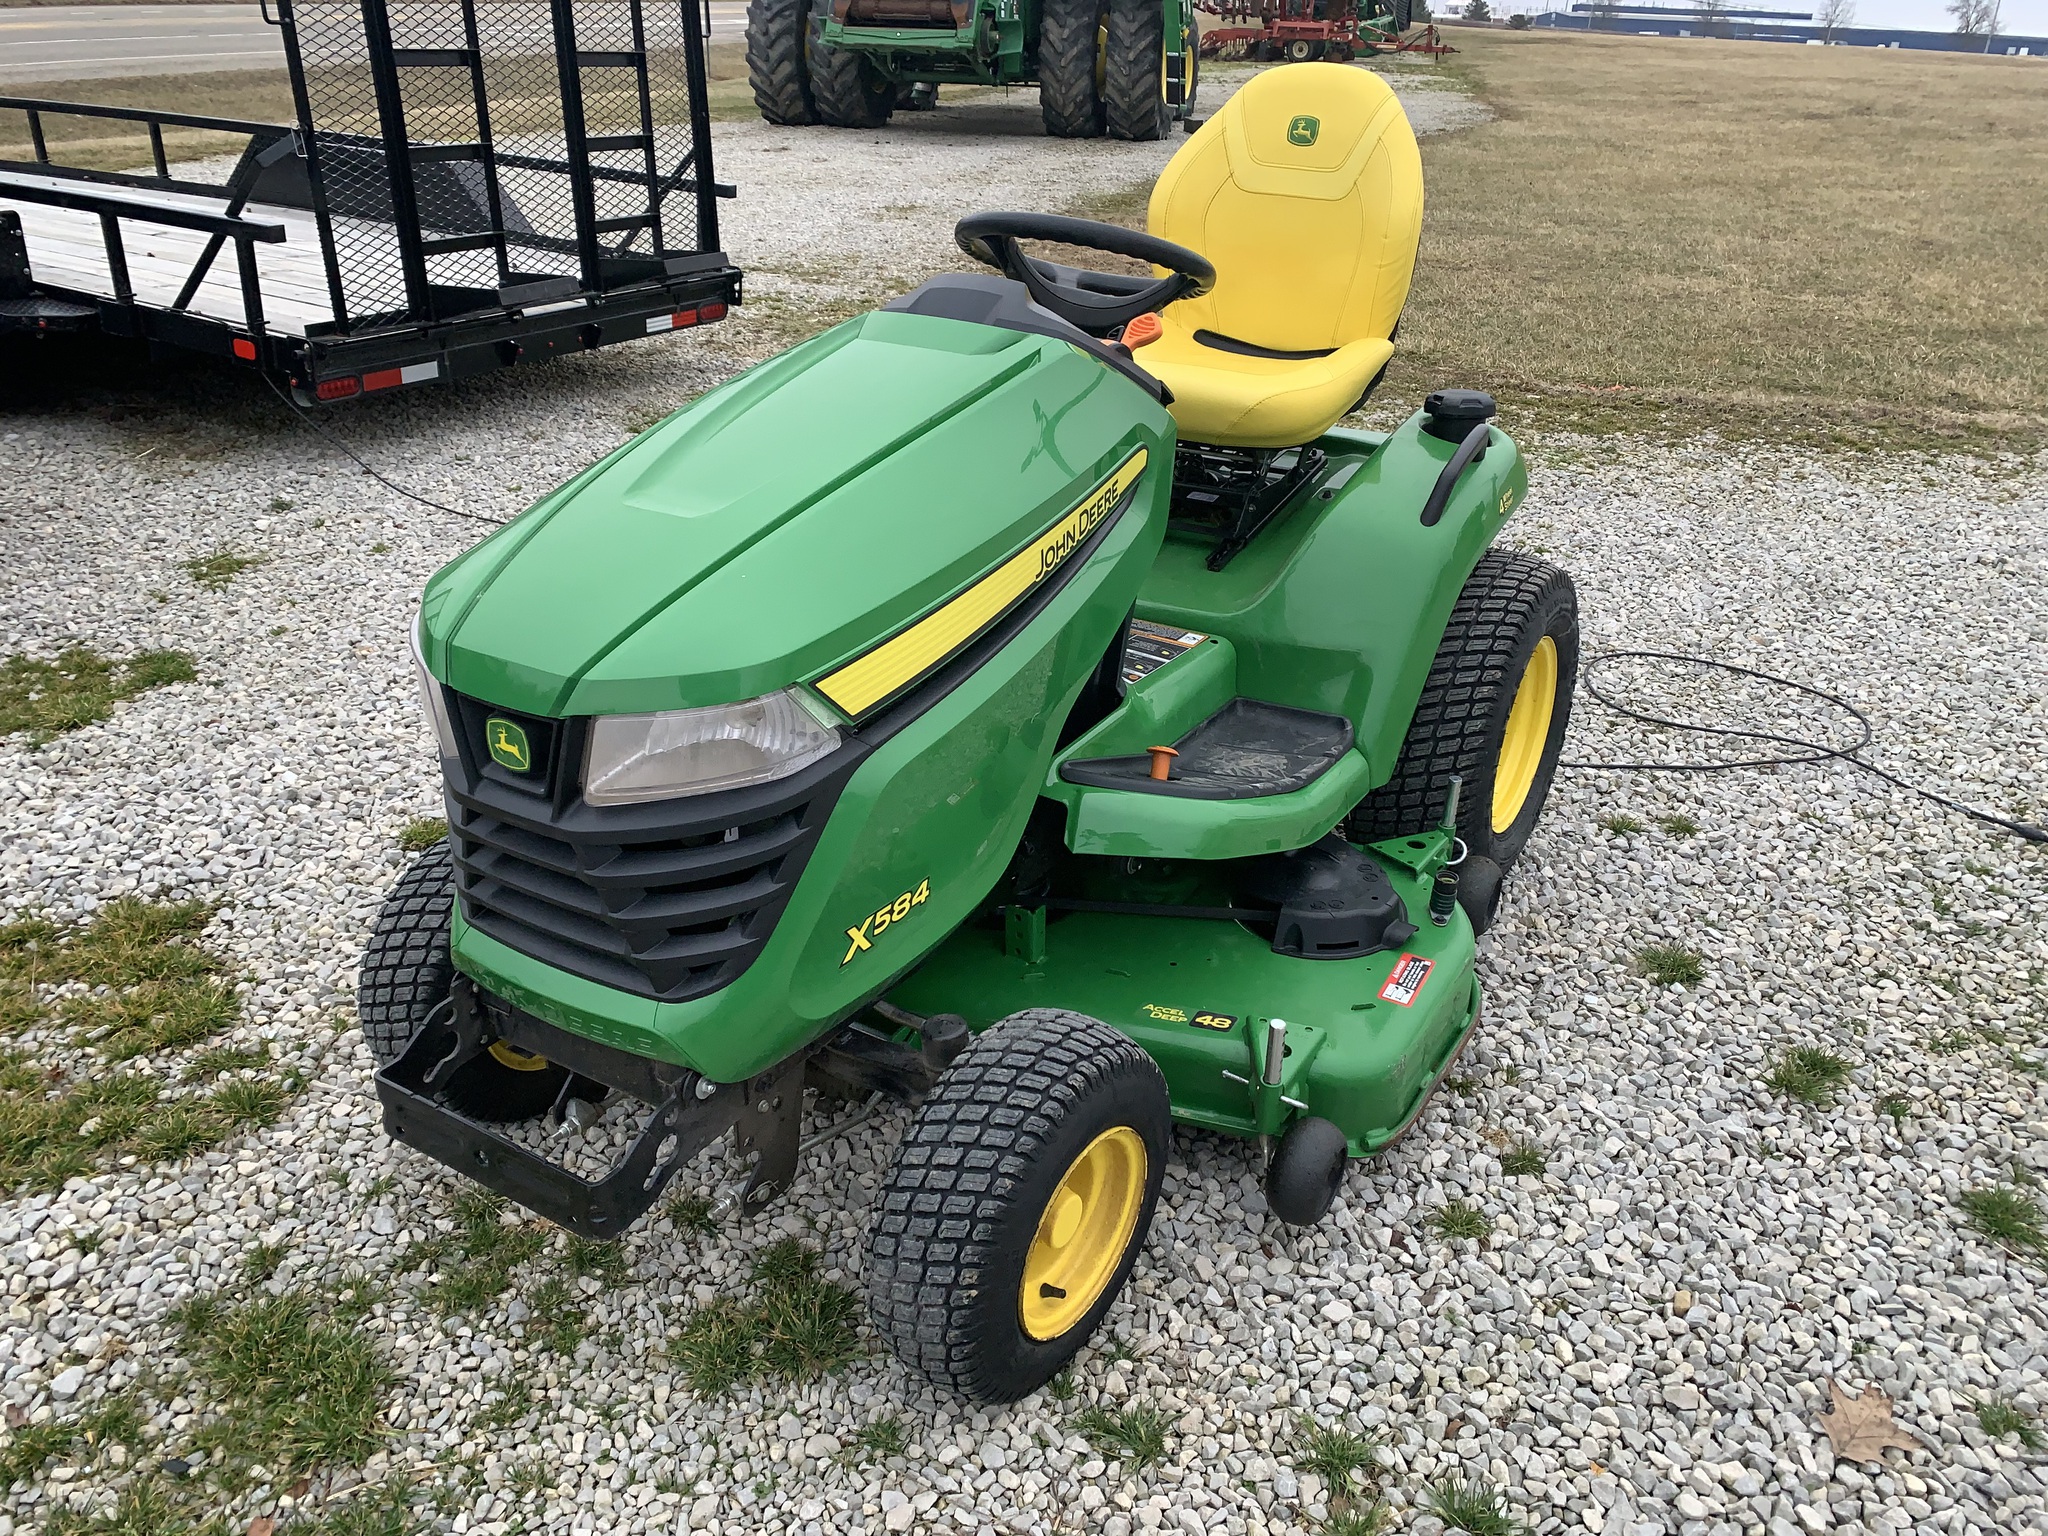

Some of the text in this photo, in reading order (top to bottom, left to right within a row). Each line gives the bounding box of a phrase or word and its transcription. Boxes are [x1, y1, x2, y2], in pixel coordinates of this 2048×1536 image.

[1035, 478, 1119, 580] JOHN DEERE
[840, 877, 930, 967] X584
[1142, 1003, 1186, 1017] ACCEL
[1149, 1011, 1188, 1023] DEEP
[1194, 1015, 1233, 1029] 48
